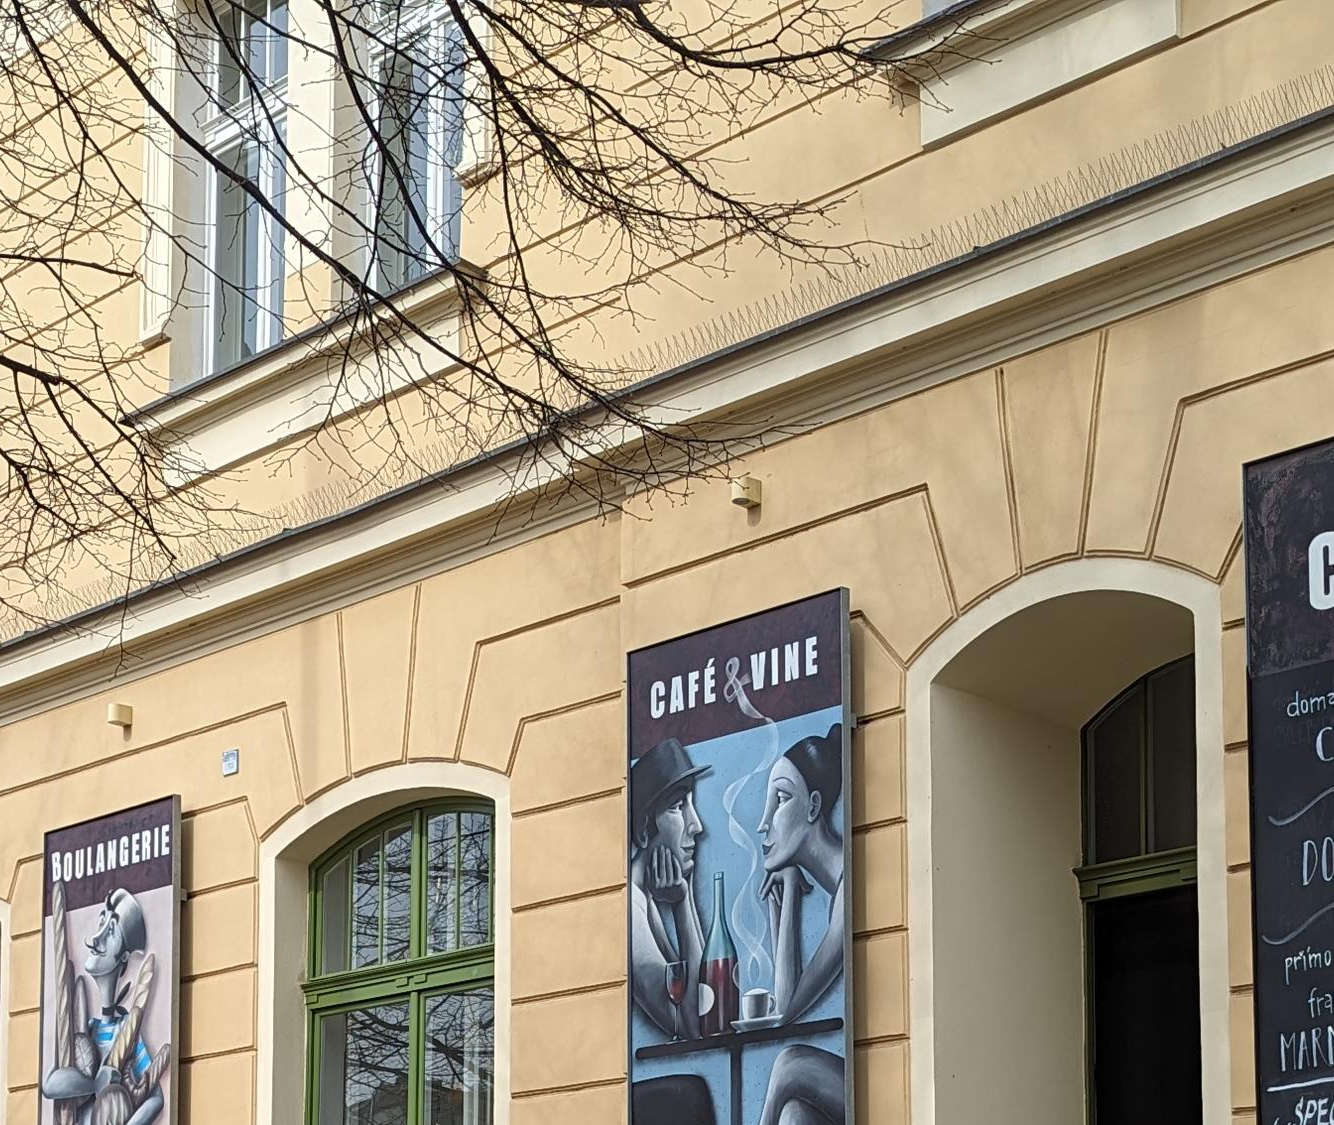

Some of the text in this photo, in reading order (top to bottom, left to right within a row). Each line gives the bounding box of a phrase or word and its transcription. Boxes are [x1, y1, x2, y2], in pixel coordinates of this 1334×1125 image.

[649, 658, 717, 720] CAFÉ
[749, 635, 820, 691] VINE
[50, 823, 171, 883] BOULANGERIE
[1284, 946, 1332, 985] přímo
